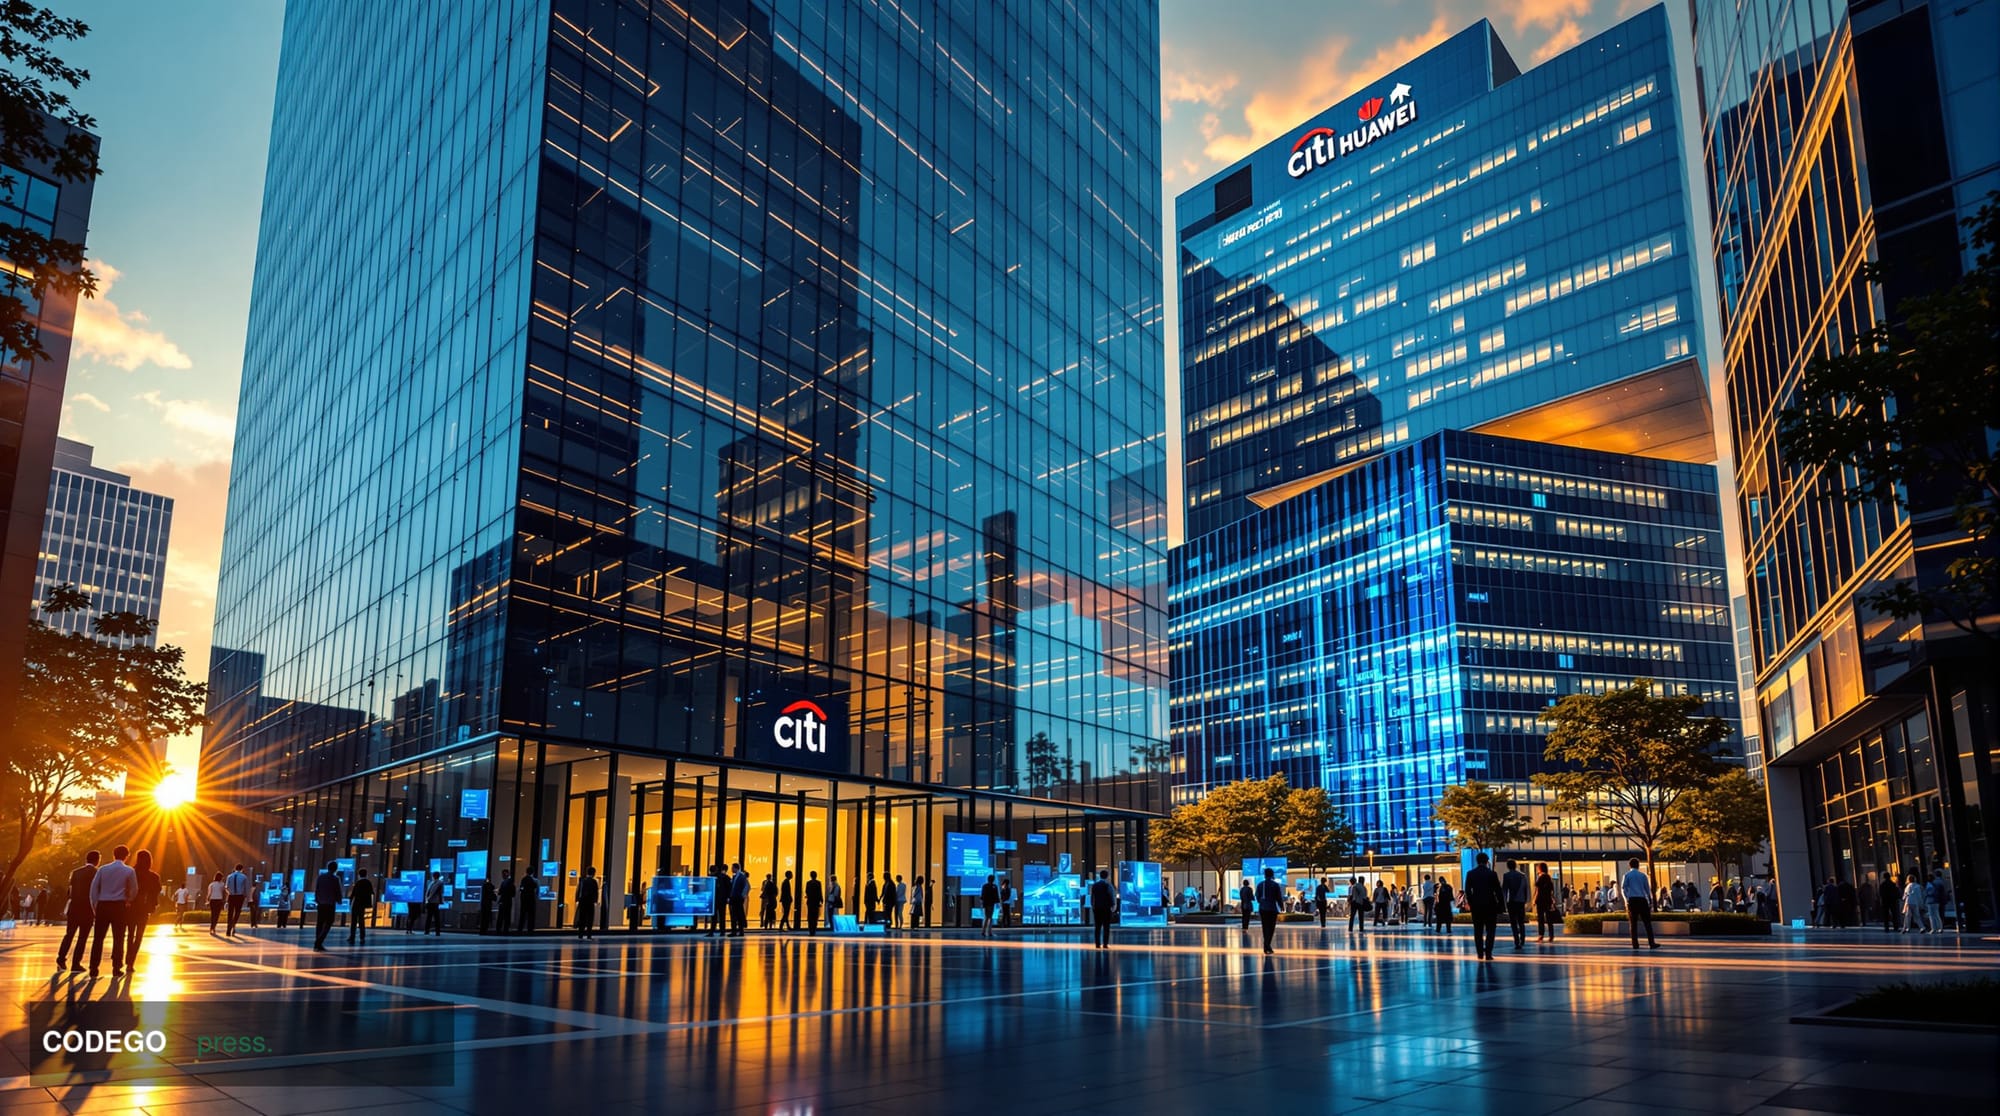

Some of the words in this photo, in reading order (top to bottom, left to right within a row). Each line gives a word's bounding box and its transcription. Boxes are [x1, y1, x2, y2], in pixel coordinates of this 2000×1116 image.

[1287, 132, 1335, 177] citi
[1339, 101, 1416, 155] HUAWEI
[774, 710, 826, 753] citi
